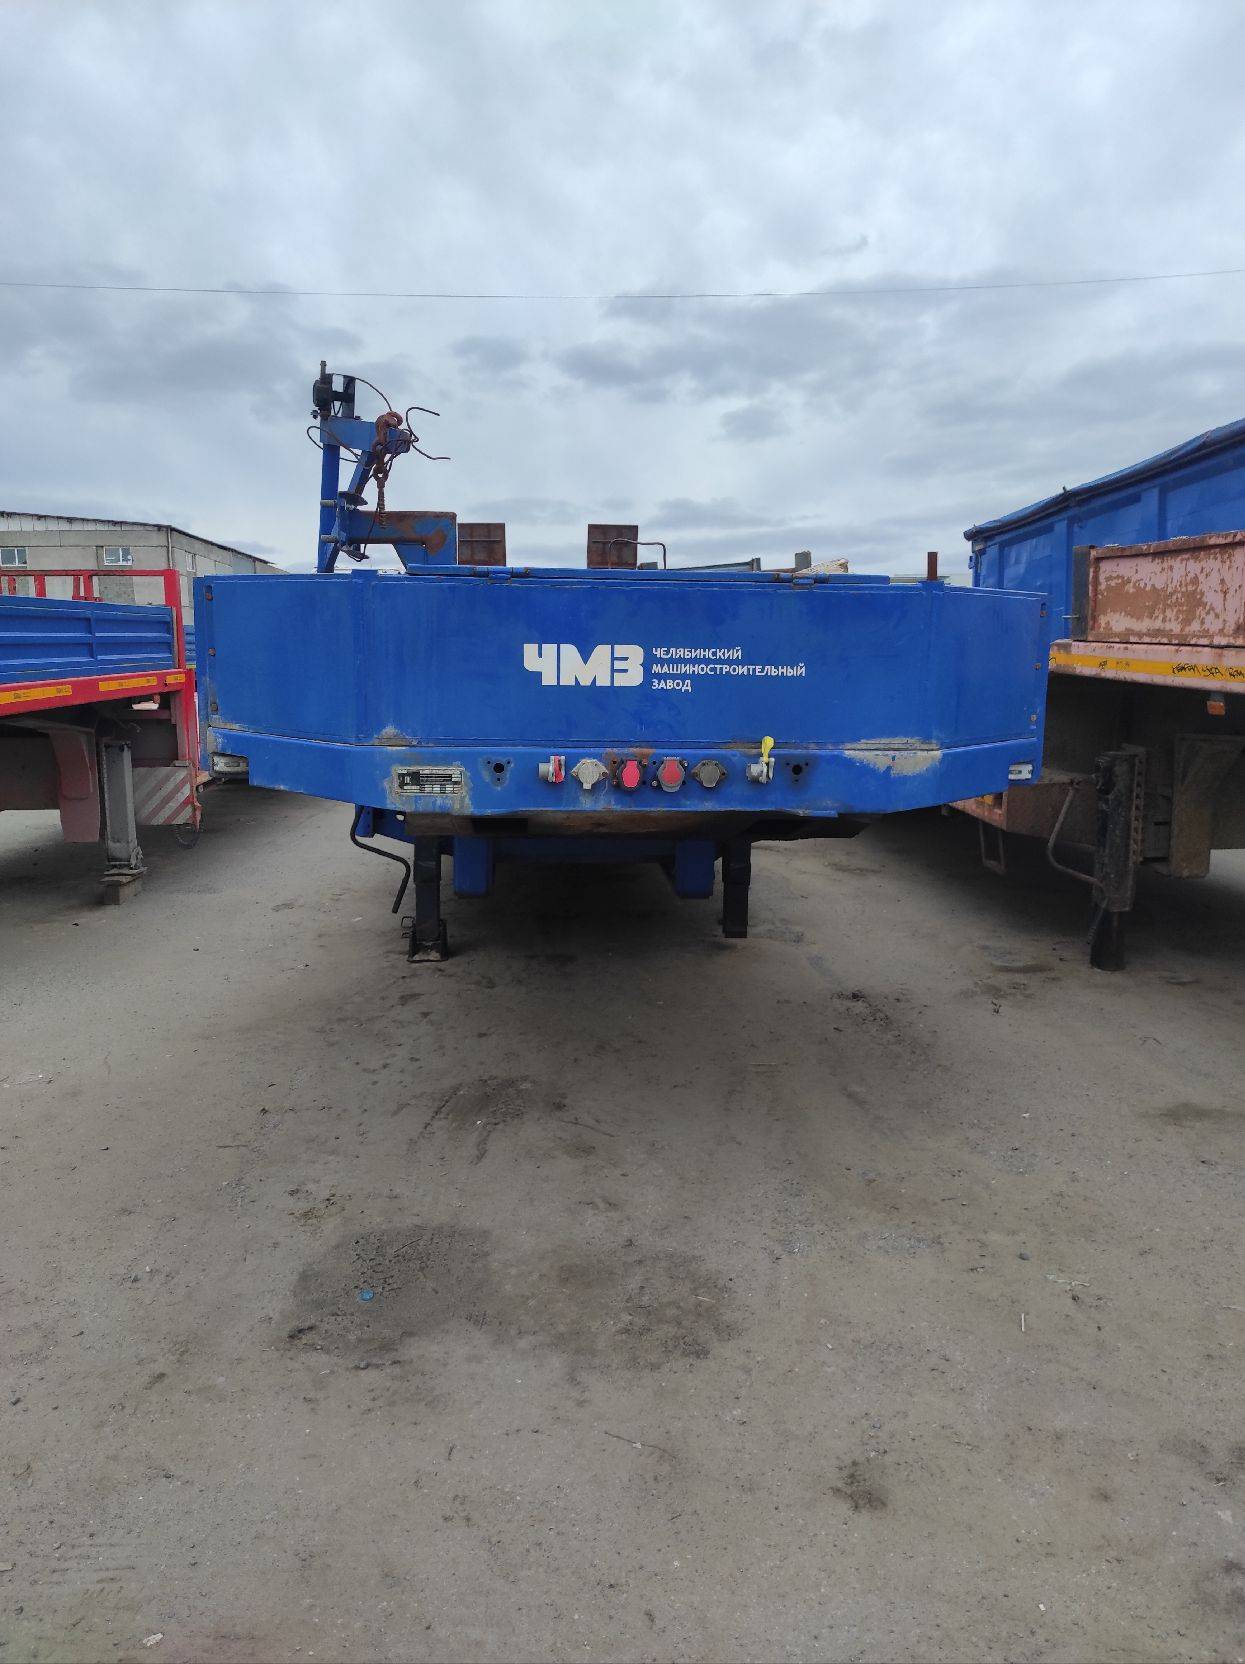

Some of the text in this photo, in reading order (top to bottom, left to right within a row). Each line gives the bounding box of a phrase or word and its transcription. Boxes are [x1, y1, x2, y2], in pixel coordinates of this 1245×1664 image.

[652, 646, 742, 660] ЧЕЛЯБИНСКИЙ
[523, 643, 644, 687] ЧМЗ
[651, 662, 806, 677] МАШИНОСТРОИТЕЛЬНЫЙ
[651, 679, 692, 693] ЗАВОД
